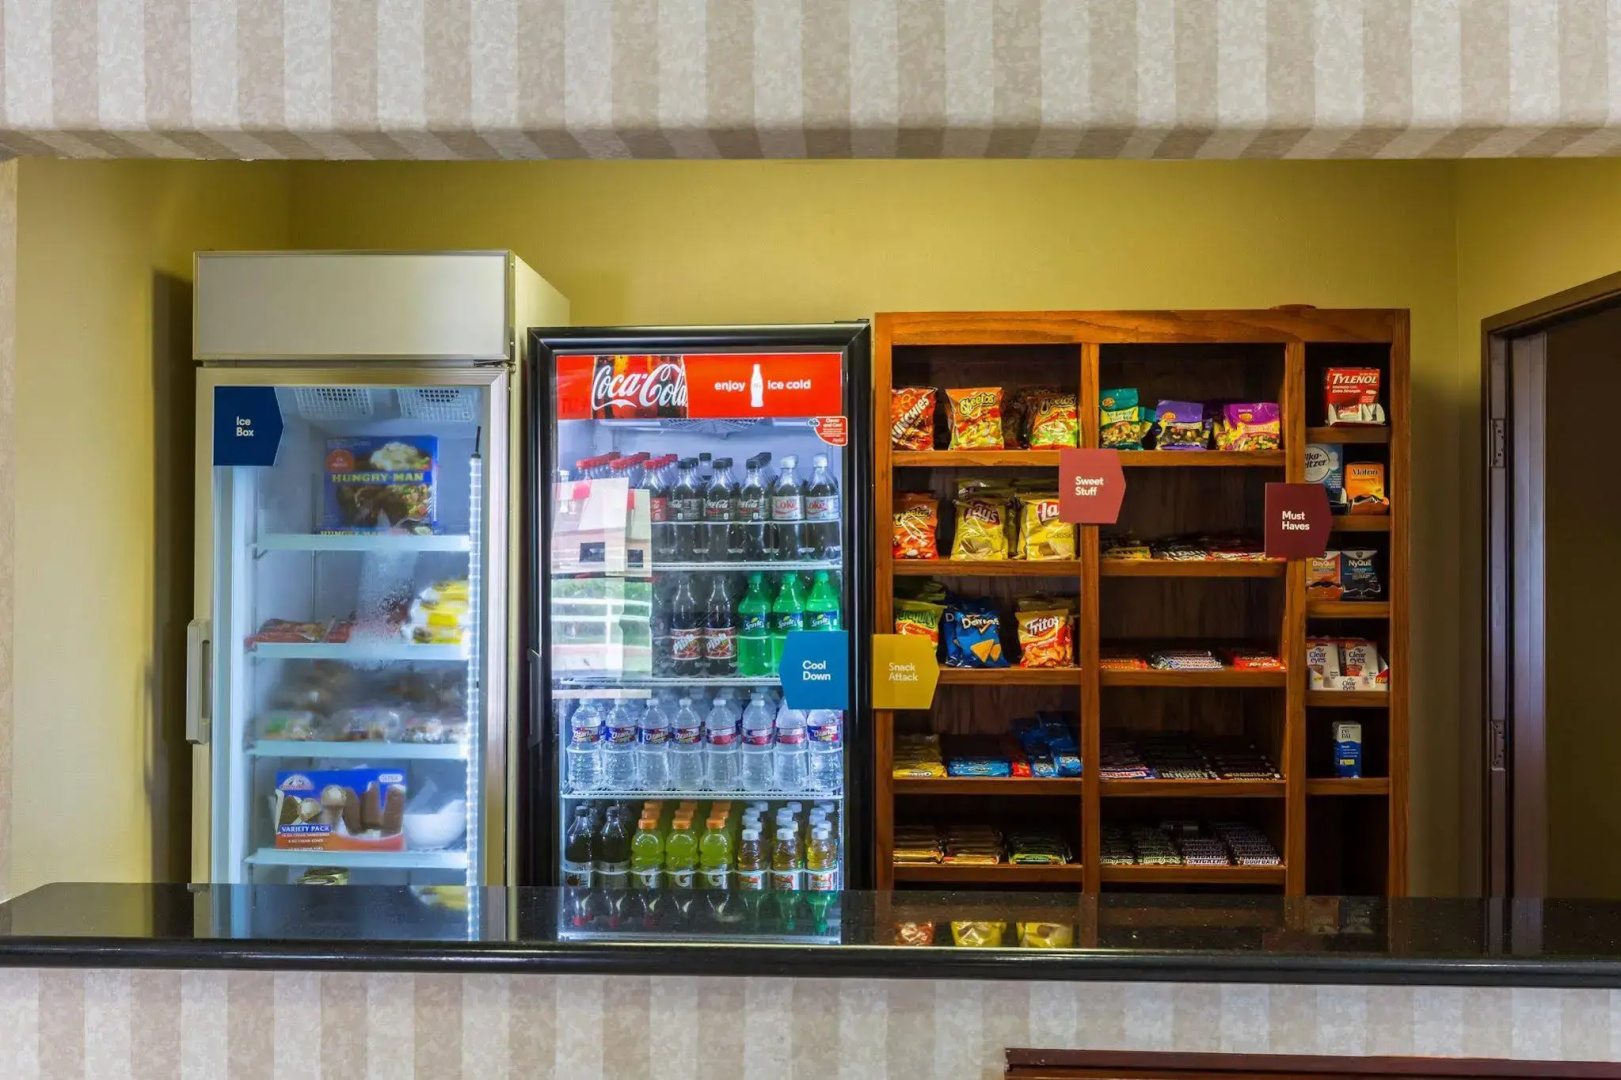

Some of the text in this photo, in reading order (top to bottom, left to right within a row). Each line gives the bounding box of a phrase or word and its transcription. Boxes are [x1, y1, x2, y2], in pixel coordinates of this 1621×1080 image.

[1332, 373, 1377, 385] TYLENOL
[591, 363, 688, 411] Coca-Cola
[714, 379, 811, 392] enjoy ice cold
[958, 393, 997, 416] Cheetos
[236, 416, 252, 426] Ice
[236, 427, 255, 437] Box
[1305, 452, 1322, 461] lka-
[1075, 475, 1104, 486] Sweet
[1075, 486, 1097, 496] Stuff
[1282, 510, 1306, 520] Must
[1282, 520, 1310, 531] Haves
[1348, 559, 1372, 567] NyQuil
[961, 616, 1000, 630] Doritos
[1024, 615, 1060, 637] Fritos
[802, 660, 826, 670] Cool
[888, 662, 916, 672] Snack
[802, 671, 831, 681] Down
[888, 672, 919, 682] Attack
